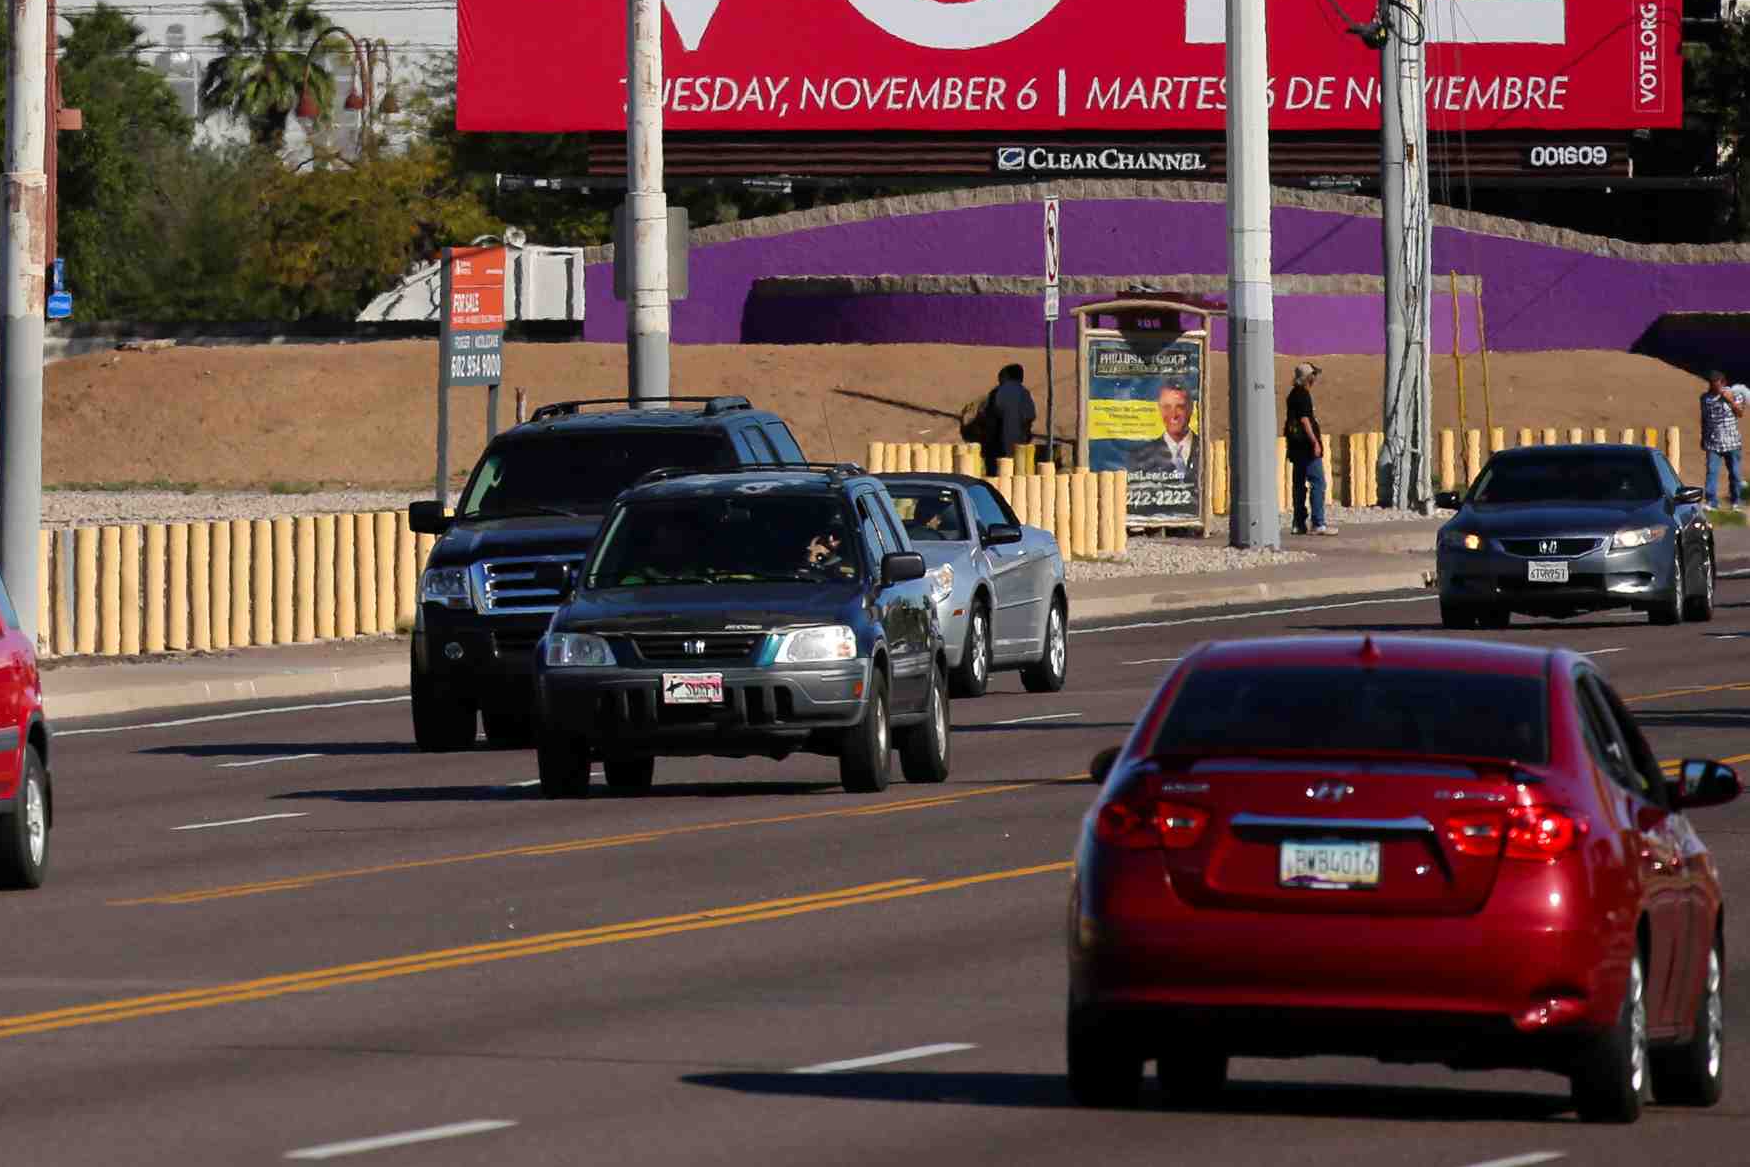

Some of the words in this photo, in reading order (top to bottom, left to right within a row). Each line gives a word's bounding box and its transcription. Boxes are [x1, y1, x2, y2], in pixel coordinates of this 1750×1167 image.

[1640, 3, 1658, 104] VOTE.ORG
[799, 77, 1007, 111] NOVEMBER
[1016, 77, 1038, 110] 6
[1285, 76, 1336, 110] DE
[1530, 145, 1608, 166] 001609
